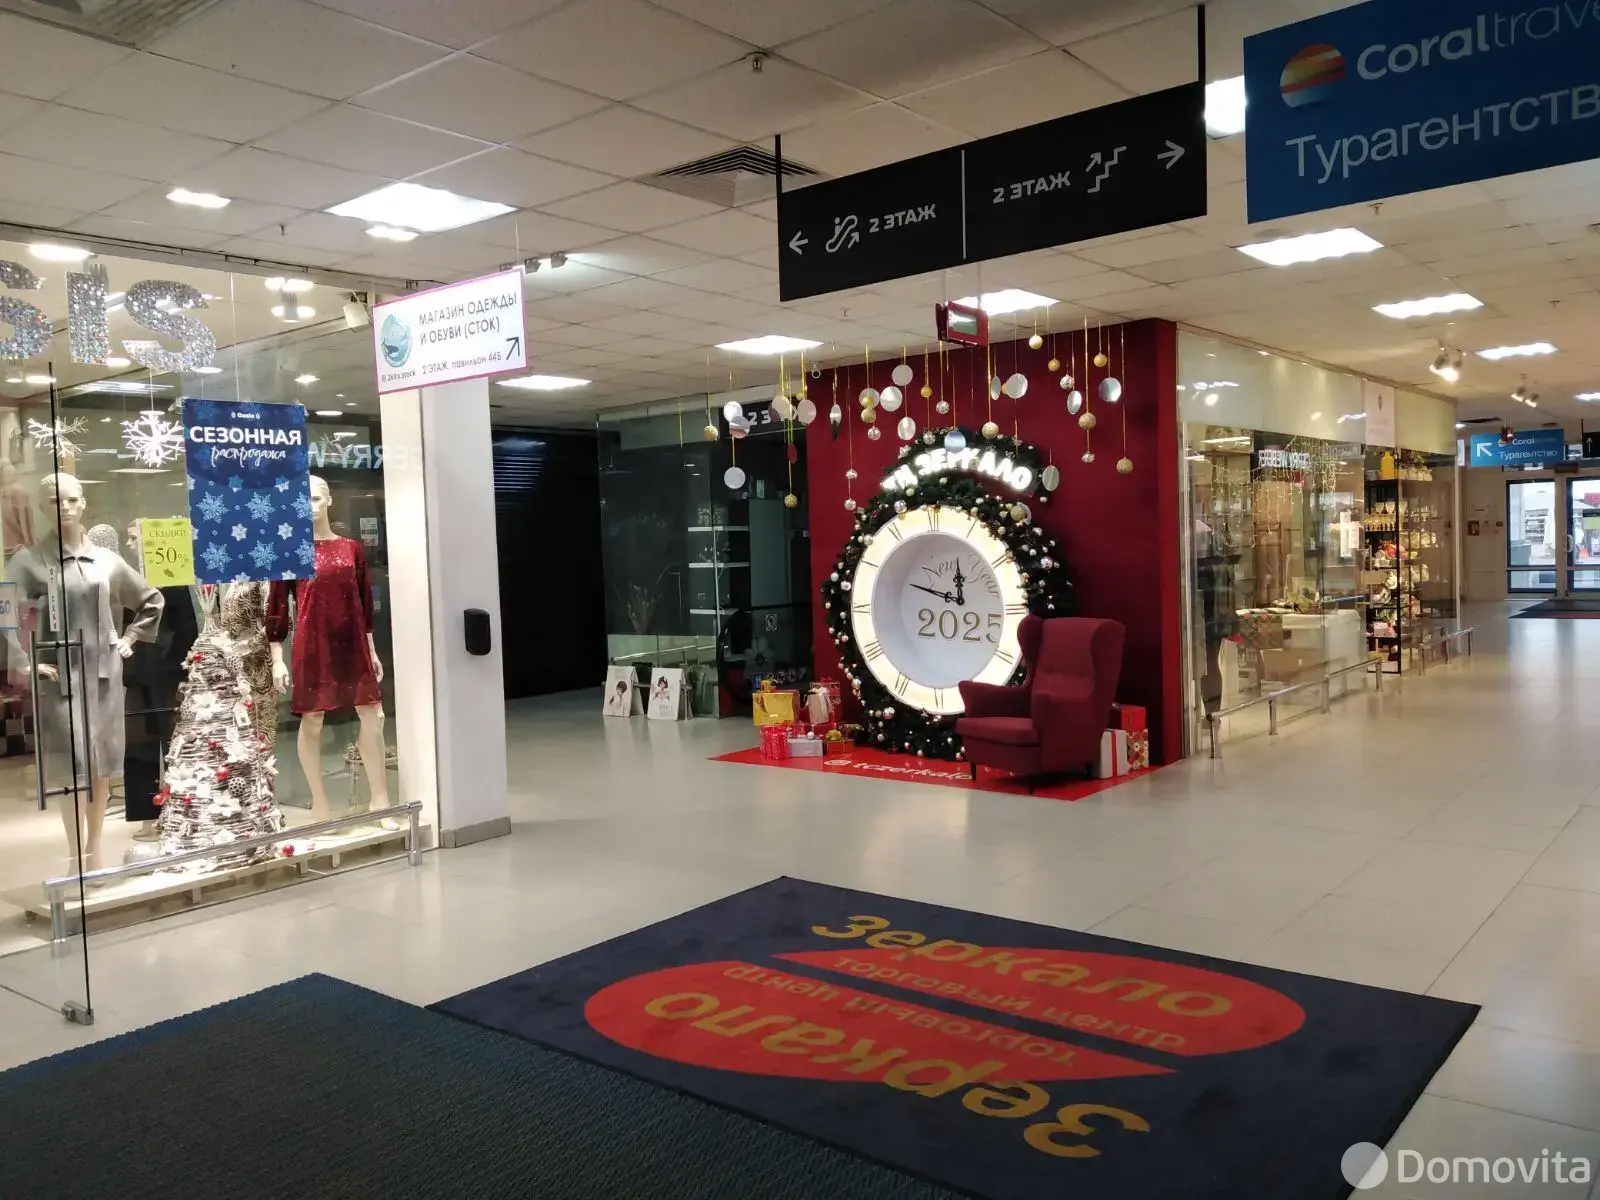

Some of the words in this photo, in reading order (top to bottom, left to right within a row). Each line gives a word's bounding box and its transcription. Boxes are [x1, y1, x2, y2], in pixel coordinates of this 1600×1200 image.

[993, 187, 1005, 204] 2
[1010, 170, 1071, 200] ЭТАЖ
[869, 217, 880, 233] 2
[884, 204, 936, 230] ЭТАЖ
[419, 304, 465, 326] МАГАЗИН
[467, 292, 517, 316] ОДЕЖДЫ
[420, 333, 427, 346] И
[429, 325, 462, 344] ОБУВИ
[464, 316, 500, 339] (СТОК)
[422, 365, 427, 375] 2
[451, 356, 487, 370] павильон
[189, 426, 302, 446] СЕЗОННАЯ
[211, 445, 287, 468] распродажа
[1498, 449, 1558, 460] Турагентство
[149, 528, 187, 538] СКИДКИ
[917, 608, 1002, 644] 2025
[723, 965, 840, 1000] центр
[812, 915, 1231, 1018] Зеркало
[1043, 1004, 1186, 1049] центр
[645, 991, 1150, 1159] Зеркало
